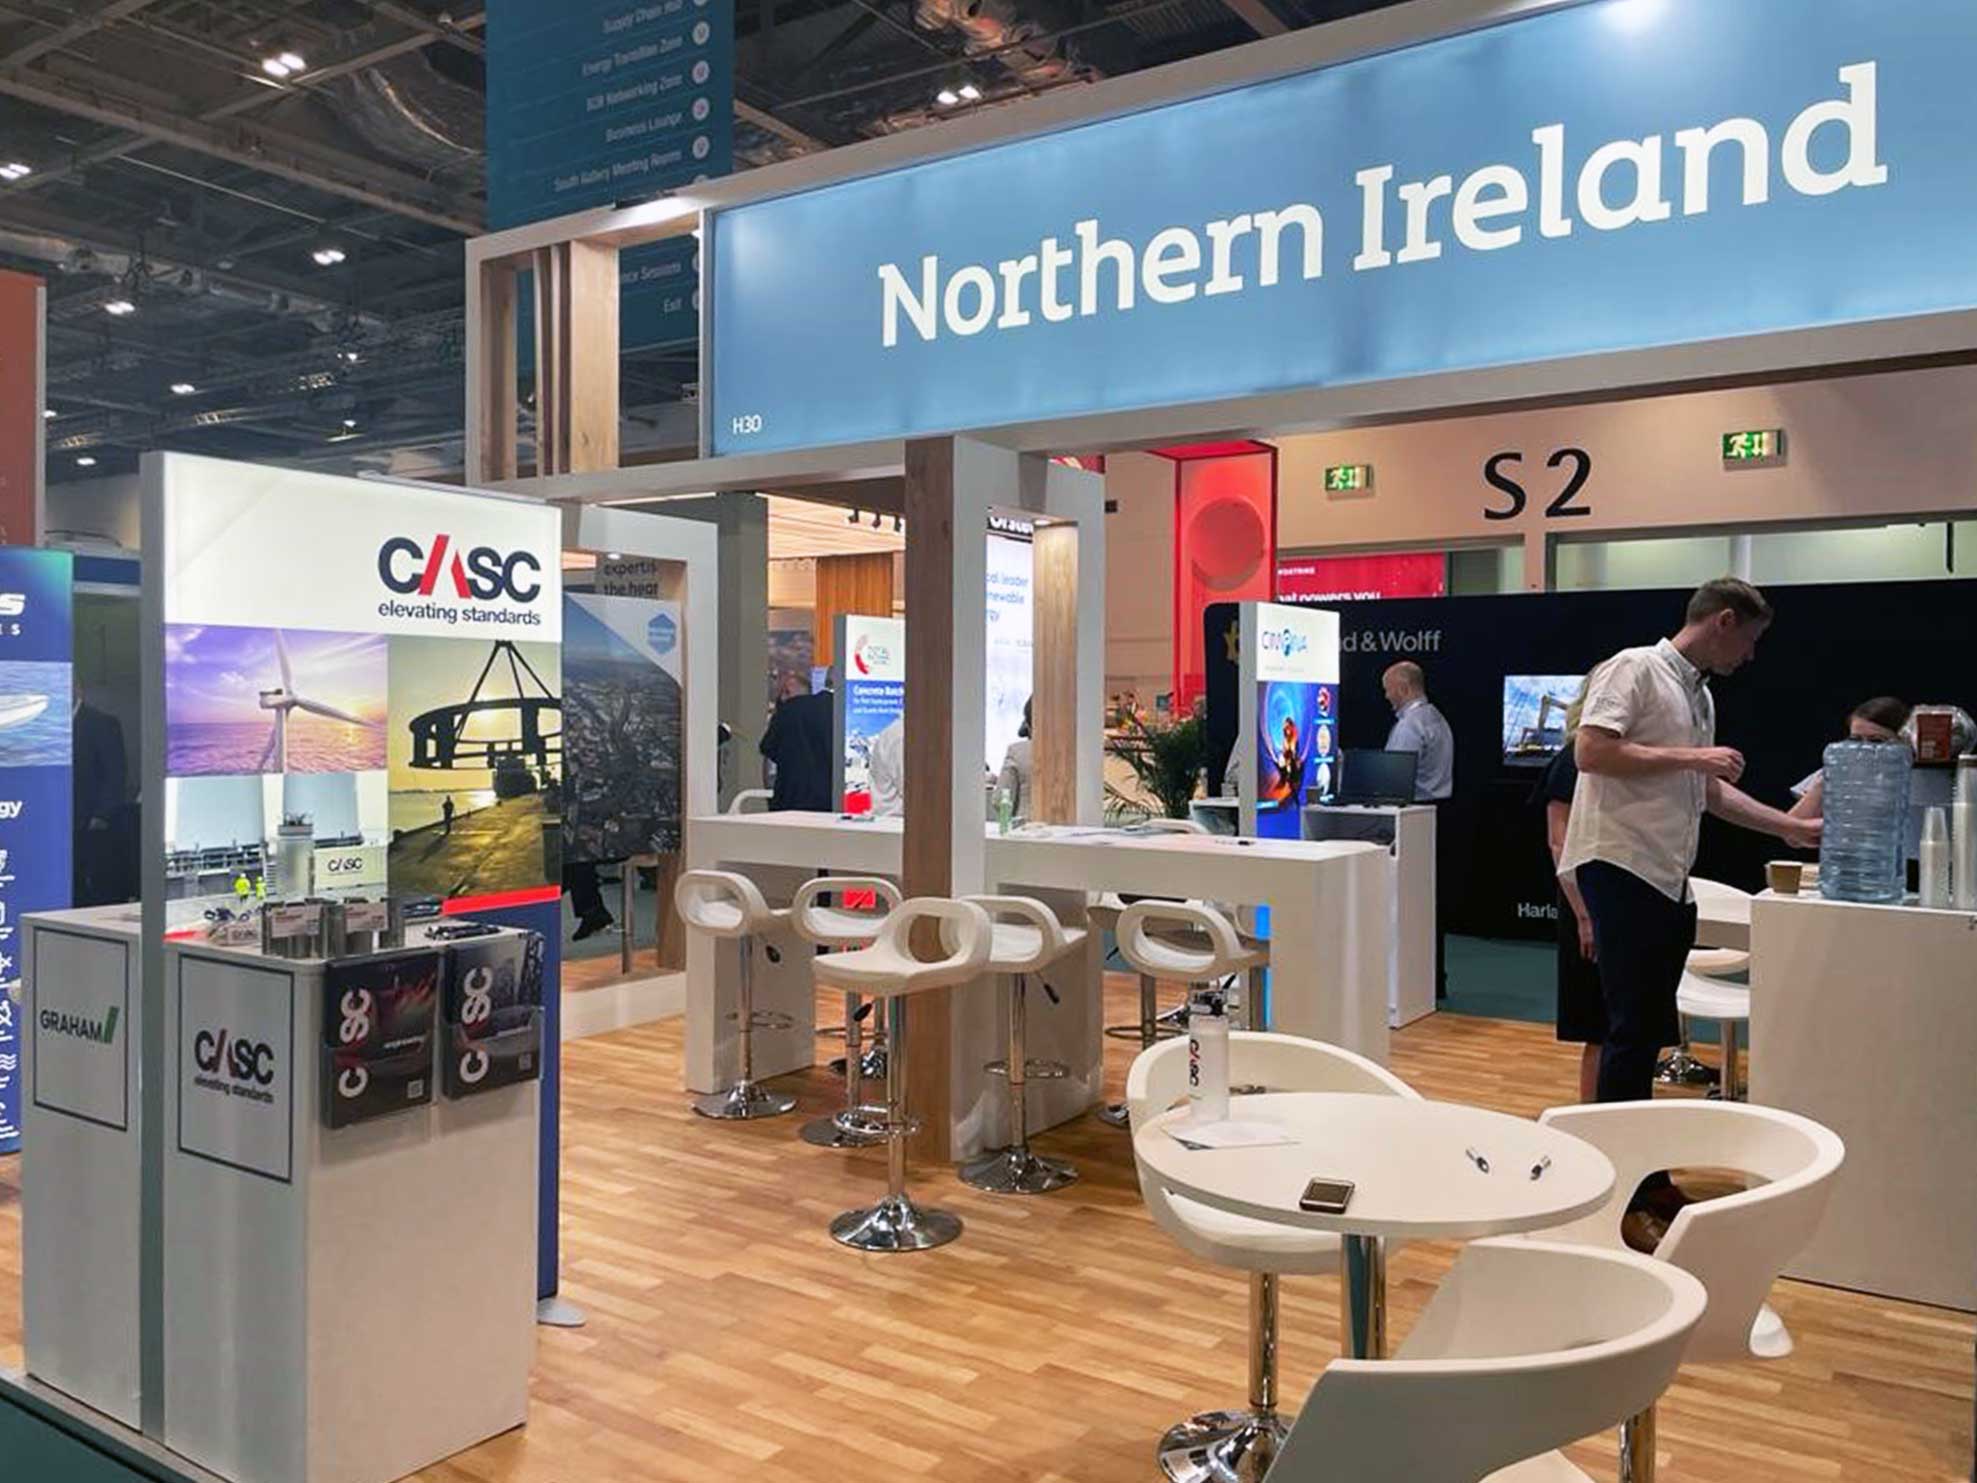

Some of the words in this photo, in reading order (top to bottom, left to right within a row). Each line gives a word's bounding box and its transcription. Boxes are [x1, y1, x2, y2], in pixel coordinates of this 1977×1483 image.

[877, 200, 1322, 347] Northern
[1353, 60, 1888, 271] Ireland
[732, 414, 762, 435] H30
[1484, 452, 1526, 520] S
[1545, 448, 1591, 518] 2
[377, 533, 542, 603] CASC
[378, 600, 458, 625] elevating
[462, 606, 541, 626] standards
[1378, 629, 1442, 652] Wolff
[39, 1009, 103, 1041] GRAHAM
[194, 1028, 275, 1086] CASC
